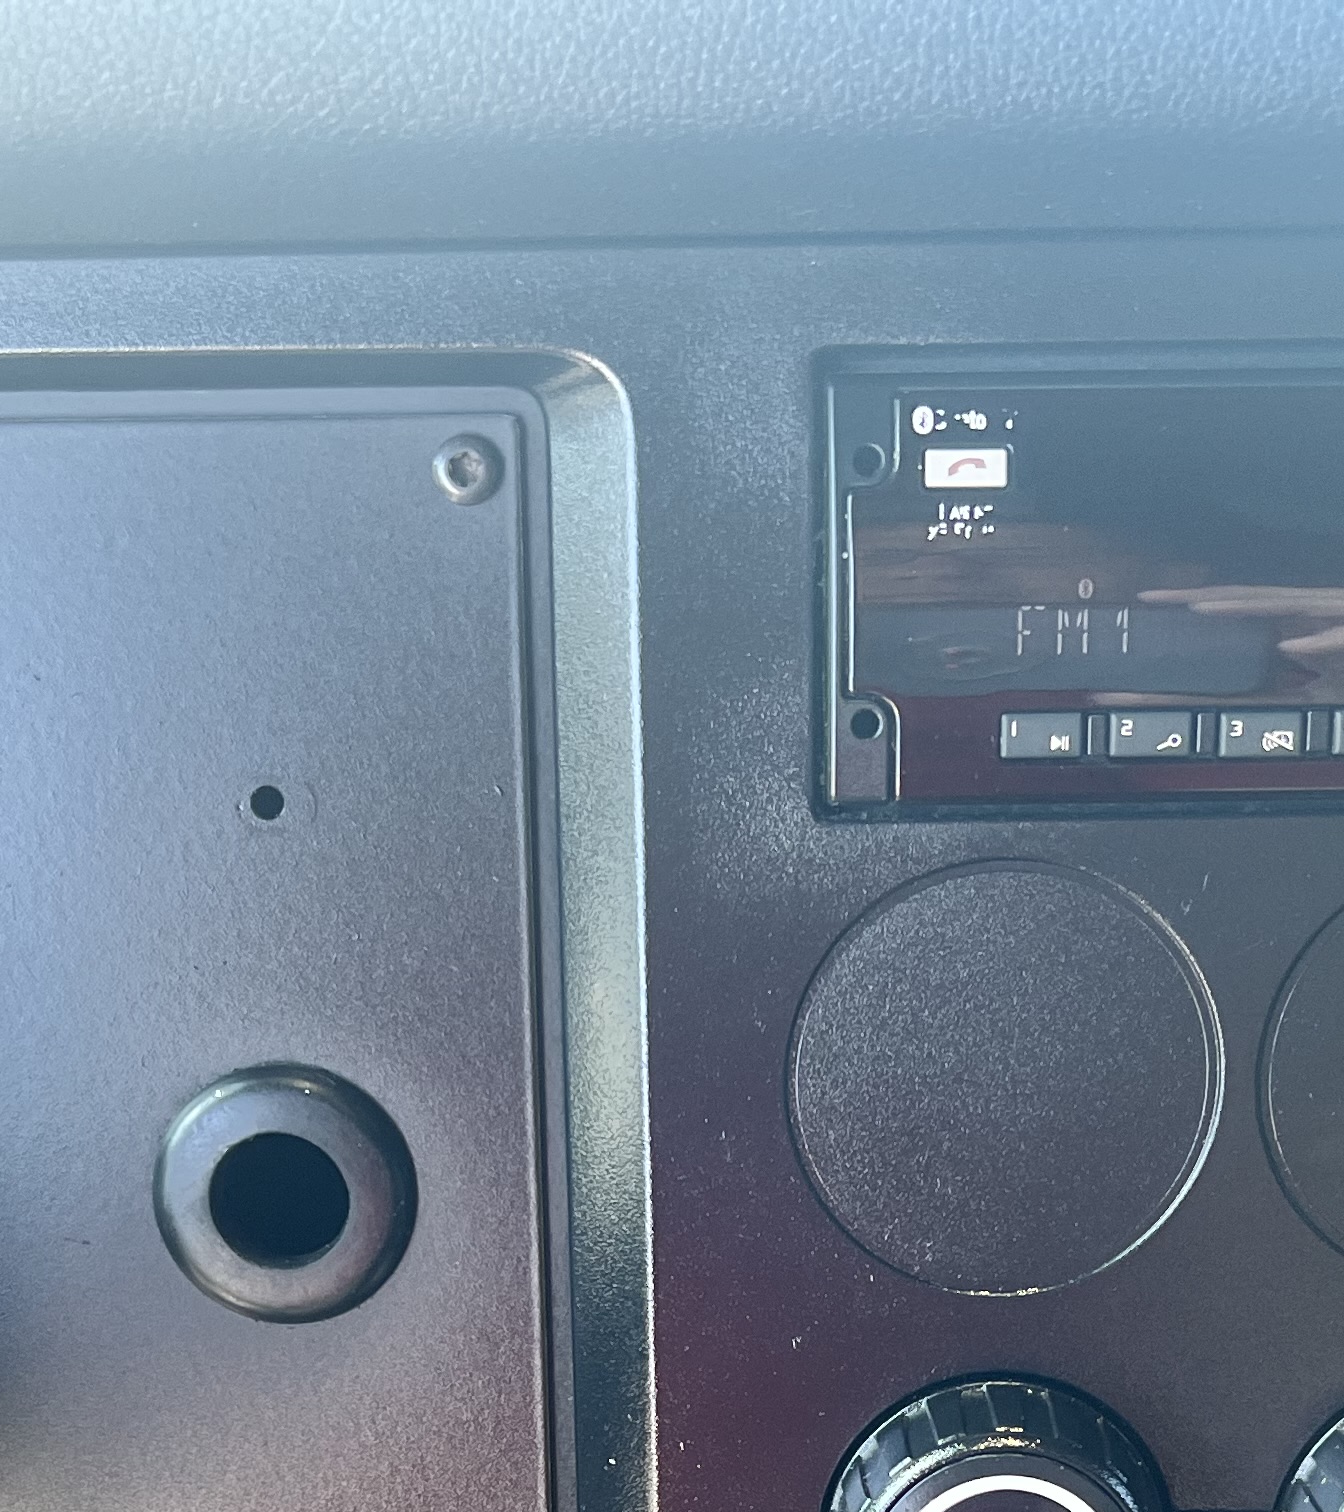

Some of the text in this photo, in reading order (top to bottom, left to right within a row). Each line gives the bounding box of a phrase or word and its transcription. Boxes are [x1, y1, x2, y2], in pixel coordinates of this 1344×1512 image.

[1010, 720, 1018, 738] 1
[1120, 720, 1134, 737] 2
[1230, 720, 1244, 737] 3
